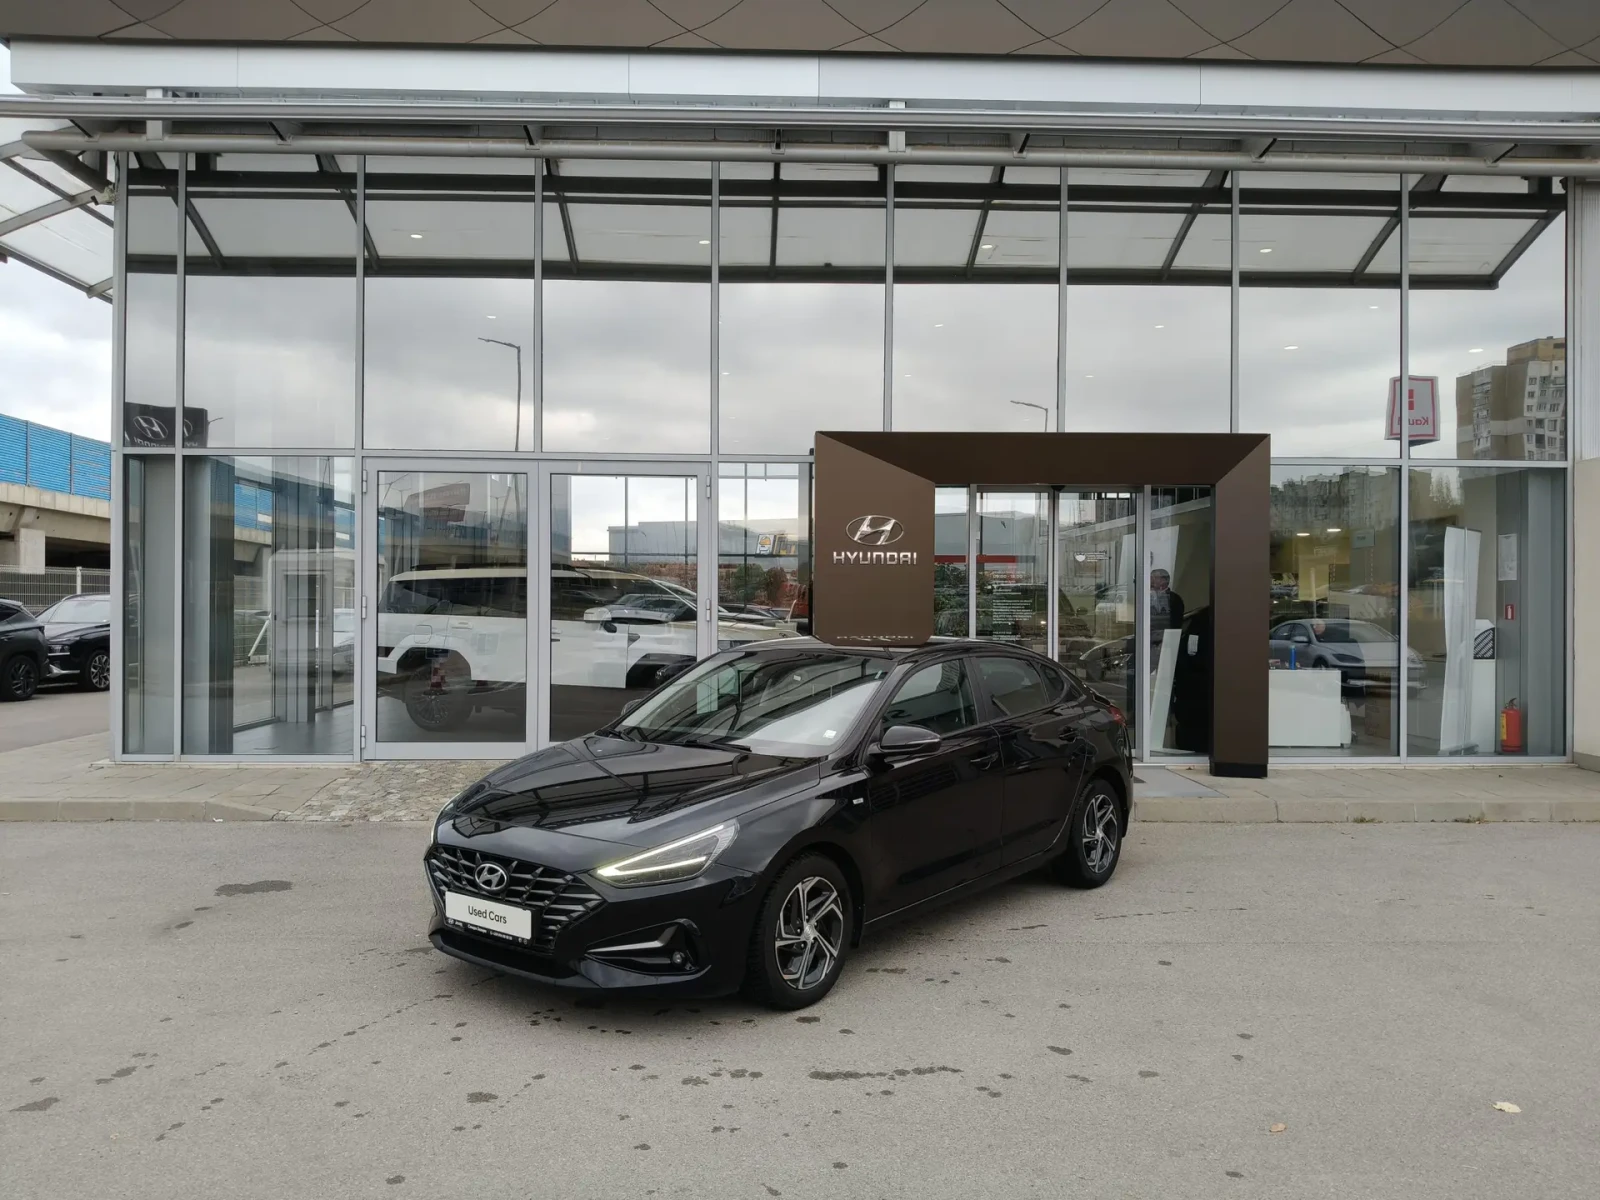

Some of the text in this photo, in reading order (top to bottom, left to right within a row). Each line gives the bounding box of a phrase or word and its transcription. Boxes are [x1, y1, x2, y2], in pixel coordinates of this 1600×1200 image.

[833, 551, 917, 565] HYUNDAI
[468, 905, 507, 924] Used Cars
